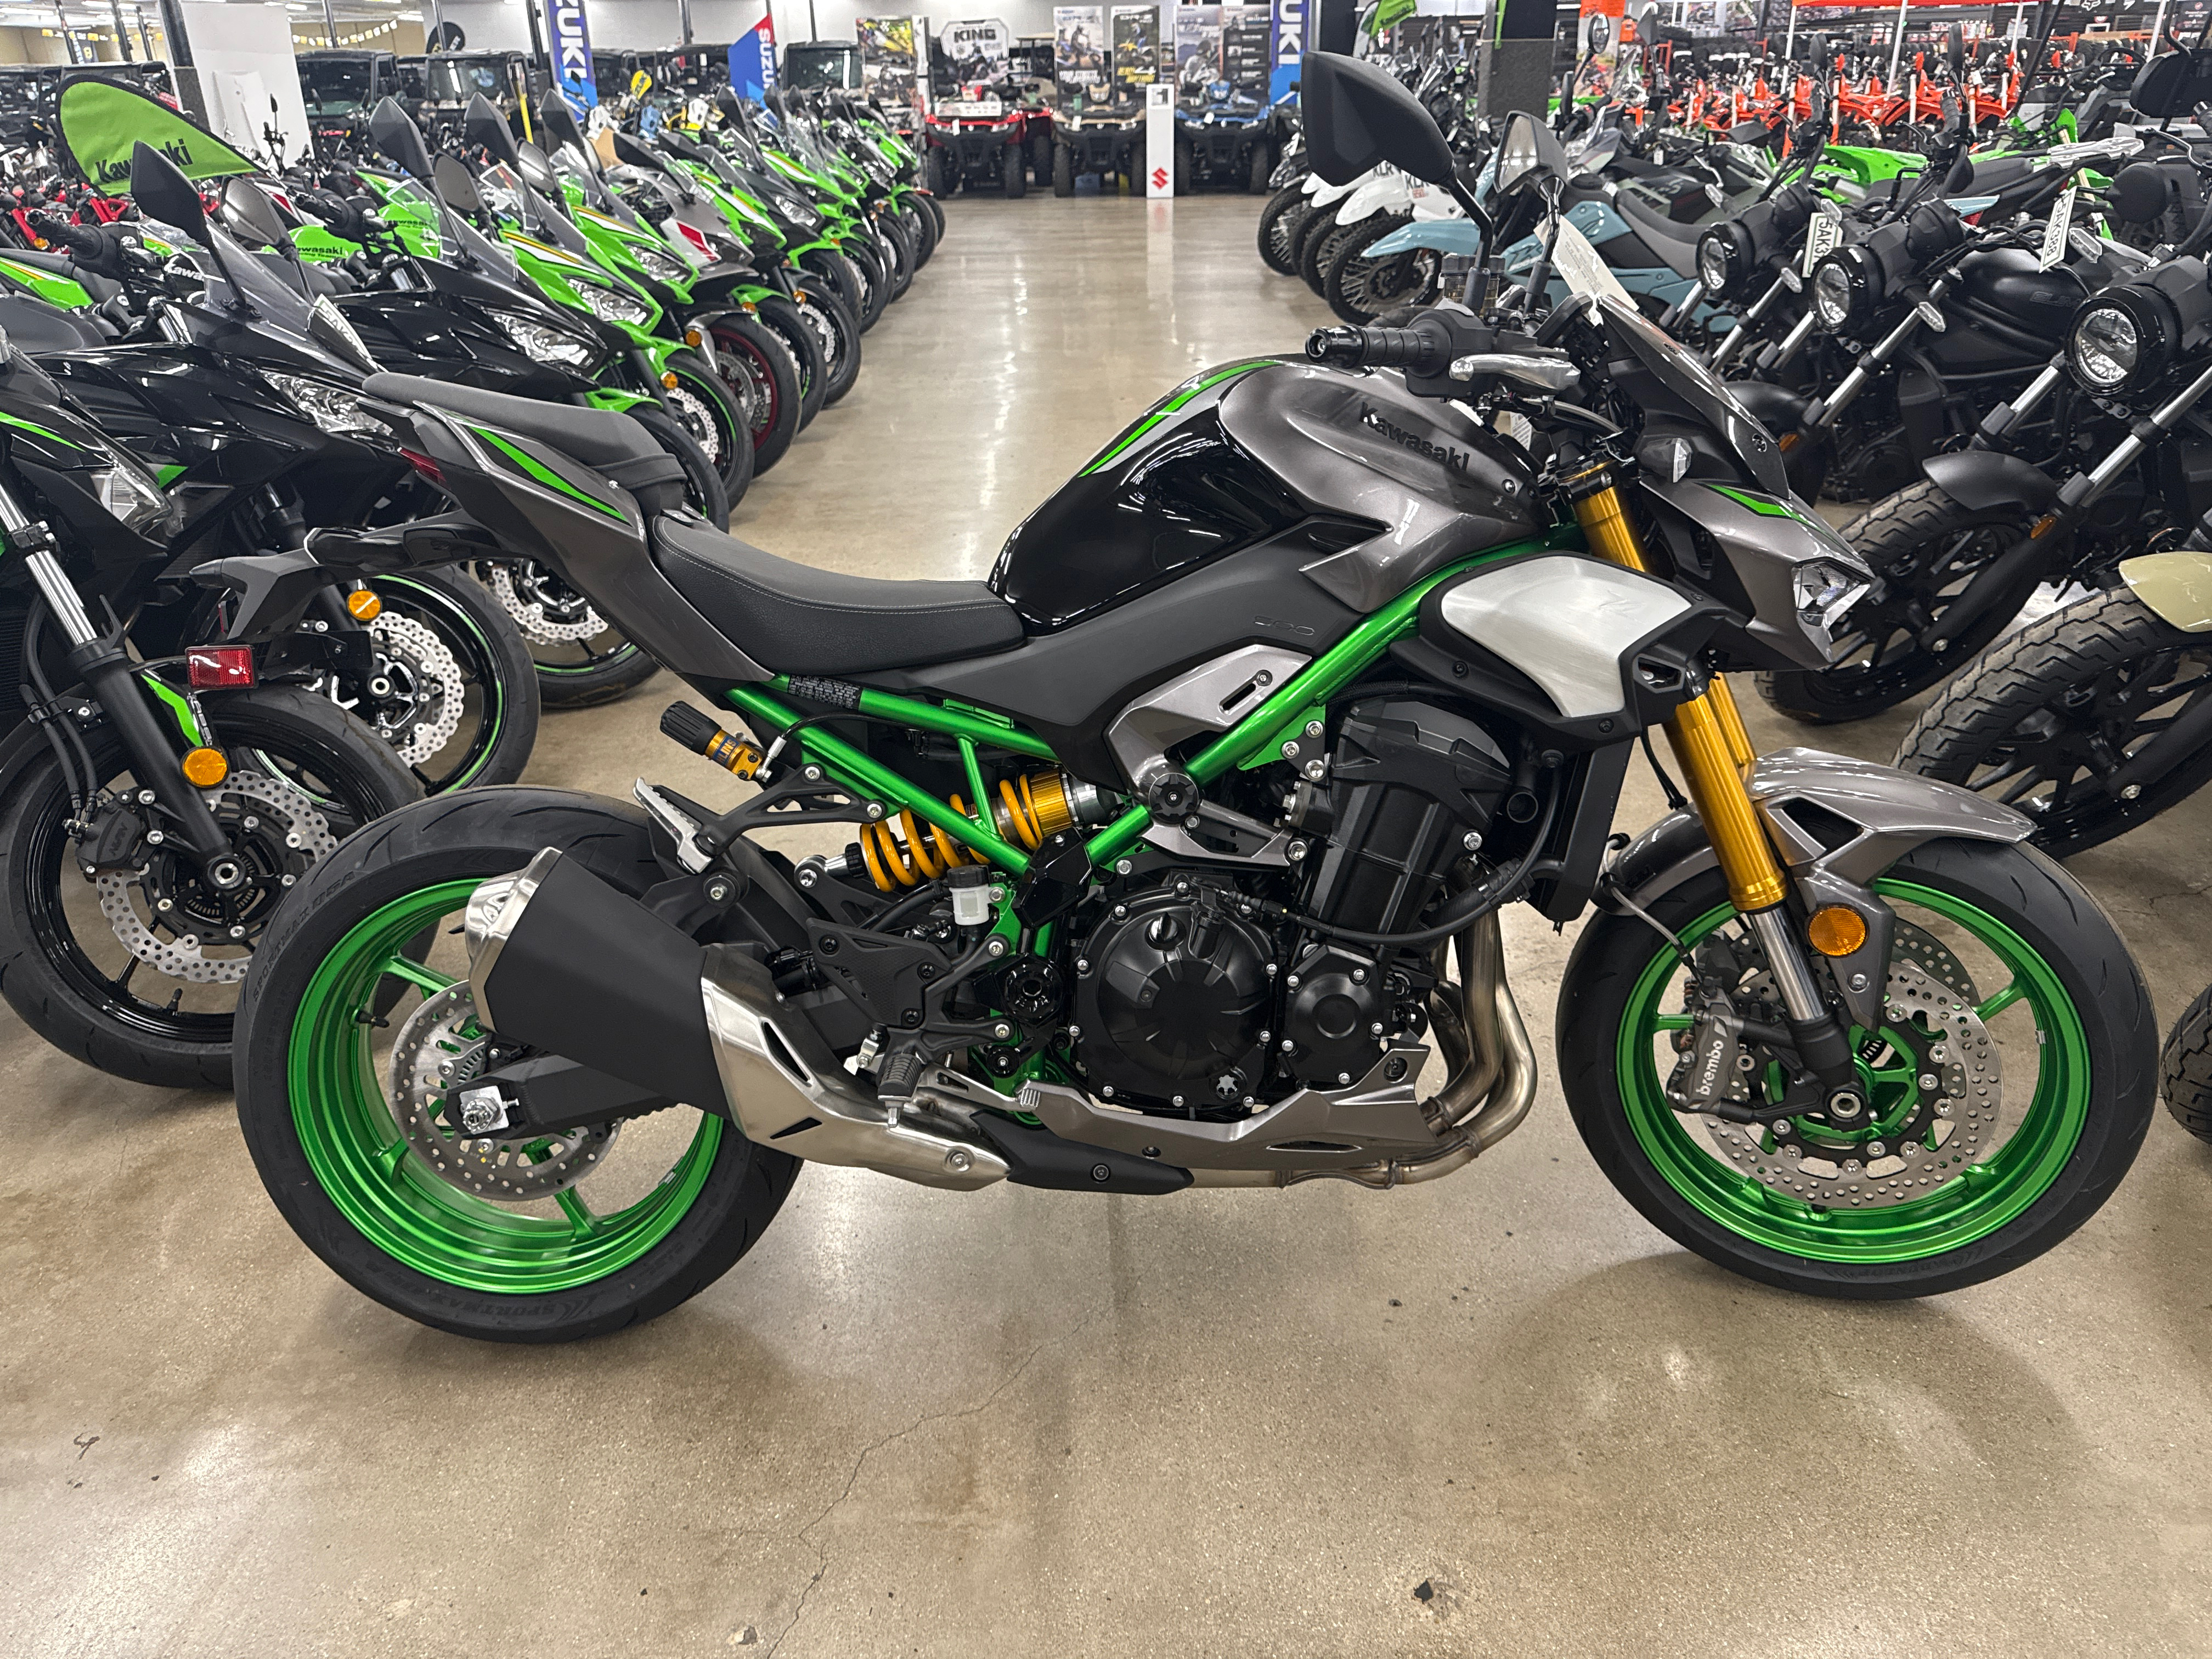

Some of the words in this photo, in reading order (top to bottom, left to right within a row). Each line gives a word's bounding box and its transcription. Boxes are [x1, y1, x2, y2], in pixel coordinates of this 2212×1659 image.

[556, 0, 588, 78] UKI
[758, 28, 775, 89] SUZU
[954, 29, 996, 43] KING
[1814, 218, 1833, 258] 5AK3
[2047, 198, 2067, 256] 5AK388
[164, 255, 205, 282] Kawa
[1359, 401, 1470, 471] Kawasaki
[1695, 1040, 1724, 1096] brembo
